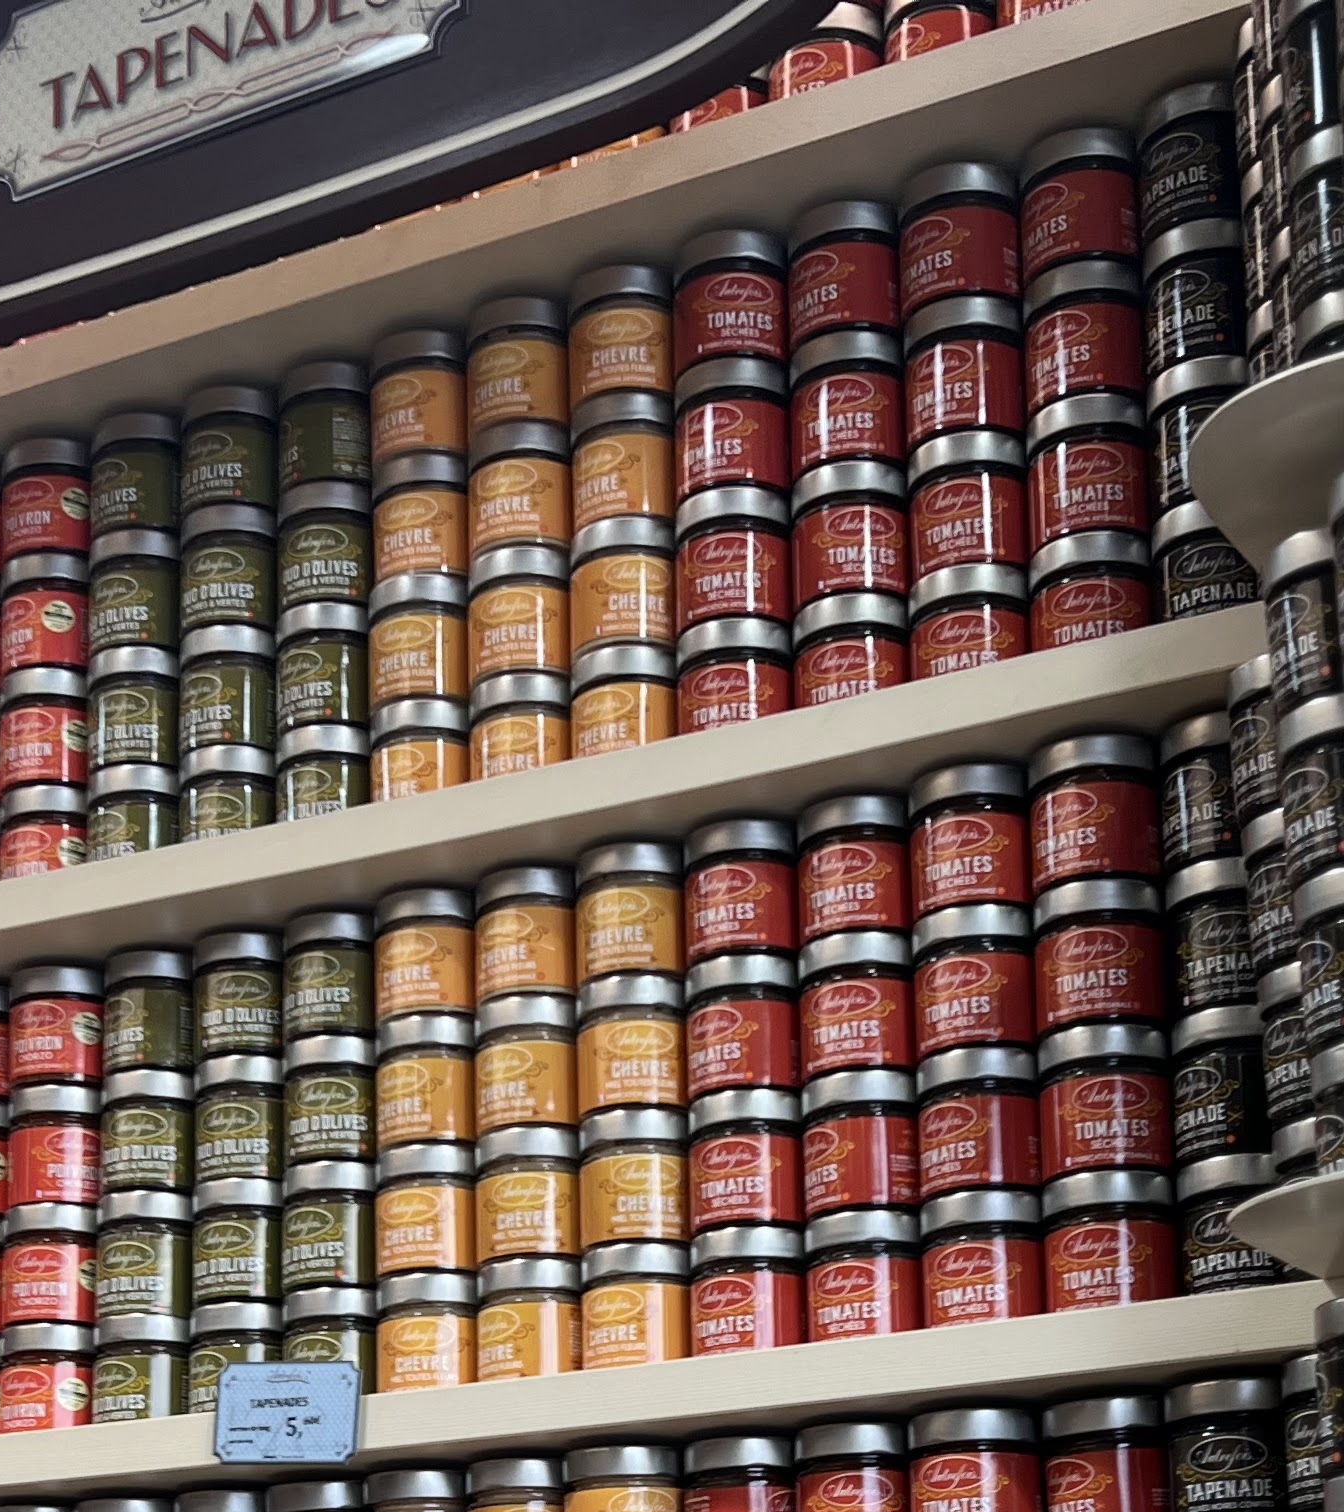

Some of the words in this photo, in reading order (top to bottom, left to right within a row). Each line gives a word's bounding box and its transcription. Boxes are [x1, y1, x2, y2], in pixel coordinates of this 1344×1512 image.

[40, 0, 398, 129] TAPENADE
[707, 312, 773, 332] TOMATES
[1053, 482, 1124, 506] TOMATES
[1173, 581, 1254, 610] TAPENADE
[926, 856, 993, 881] TOMATES
[811, 881, 876, 905] TOMATES
[1056, 968, 1128, 991] TOMATES
[1075, 1118, 1150, 1139] TOMATES
[1191, 1249, 1271, 1275] TAPENADE
[936, 1284, 1005, 1305] TOMATES
[1186, 1480, 1273, 1500] TAPENADE
